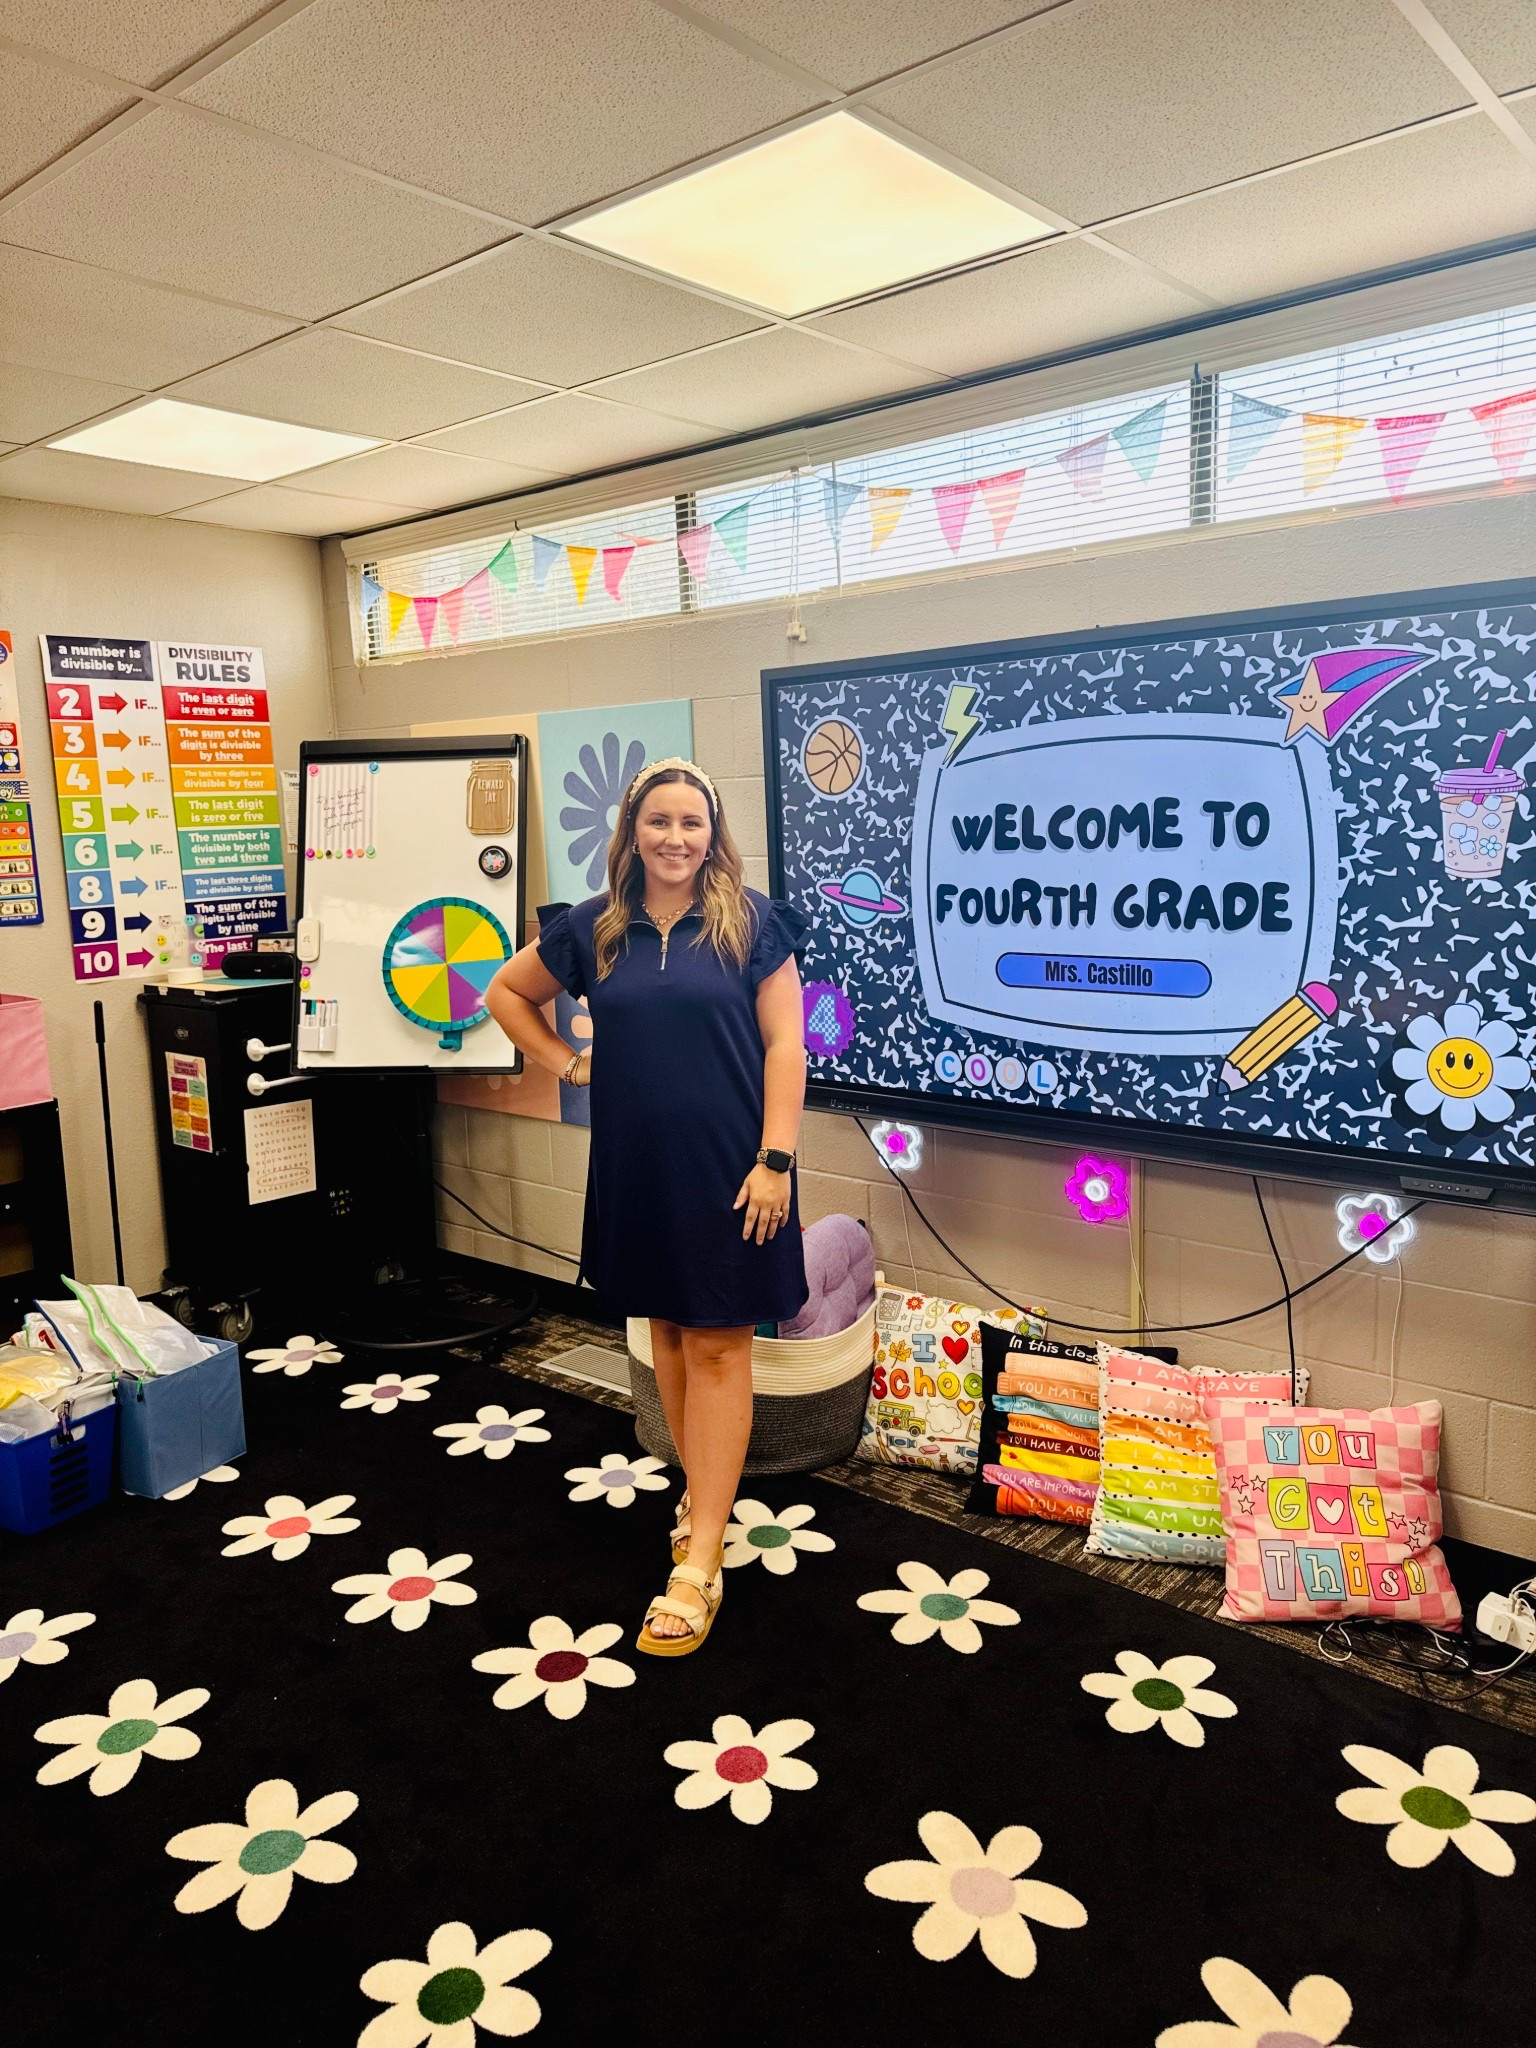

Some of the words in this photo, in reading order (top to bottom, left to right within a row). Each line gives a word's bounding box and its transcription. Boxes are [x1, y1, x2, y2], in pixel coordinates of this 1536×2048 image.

[58, 645, 68, 655] a
[71, 645, 126, 658] number
[129, 647, 142, 659] is
[168, 647, 253, 662] DIVISIBILITY
[60, 658, 114, 671] divisible
[176, 662, 251, 683] RULES
[57, 687, 82, 717] 2
[178, 692, 200, 703] The
[202, 693, 224, 704] last
[226, 694, 254, 706] digit
[181, 705, 190, 714] is
[192, 707, 216, 717] even
[218, 707, 230, 715] or
[231, 708, 254, 717] zero
[62, 725, 86, 754] 3
[178, 728, 198, 738] The
[201, 730, 225, 739] sum
[227, 729, 240, 738] of
[242, 729, 261, 739] the
[180, 740, 208, 750] digits
[210, 740, 218, 749] is
[220, 741, 261, 750] divisible
[199, 751, 212, 762] by
[215, 752, 244, 762] three
[65, 763, 91, 791] 4
[228, 770, 249, 778] digits
[184, 780, 226, 788] divisible
[228, 780, 241, 789] by
[244, 780, 264, 788] four
[478, 778, 504, 791] REWARD
[188, 800, 209, 810] The
[212, 800, 234, 810] last
[236, 798, 264, 810] digit
[485, 791, 497, 805] JAR
[72, 801, 94, 829] 5
[191, 813, 200, 822] is
[203, 814, 226, 823] zero
[229, 813, 241, 821] or
[244, 812, 264, 822] five
[952, 797, 1184, 852] WELCOME
[1202, 800, 1270, 848] TO
[188, 832, 210, 842] The
[212, 831, 258, 842] number
[260, 830, 270, 840] is
[74, 838, 98, 866] 6
[191, 844, 232, 853] divisible
[234, 842, 246, 852] by
[248, 842, 270, 852] both
[194, 856, 216, 866] two
[218, 854, 238, 864] and
[240, 852, 269, 862] three
[195, 878, 209, 886] The
[211, 876, 226, 885] last
[226, 876, 248, 884] three
[250, 874, 272, 884] digits
[79, 876, 103, 904] 8
[196, 887, 208, 895] are
[209, 885, 242, 894] divisible
[242, 885, 252, 893] by
[254, 884, 274, 892] eight
[194, 904, 216, 914] The
[218, 902, 242, 913] sum
[244, 900, 257, 910] of
[259, 898, 278, 908] the
[936, 878, 1097, 928] FOURTH
[1113, 878, 1293, 932] GRADE
[226, 913, 235, 921] is
[237, 910, 276, 920] divisible
[82, 910, 106, 939] 9
[218, 924, 232, 936] by
[234, 922, 259, 933] nine
[204, 944, 224, 954] The
[227, 942, 248, 953] last
[80, 950, 114, 974] 10
[1044, 960, 1083, 984] Mrs.
[1087, 961, 1154, 987] Castillo
[808, 994, 842, 1046] 4
[940, 1055, 1051, 1089] COOL
[912, 1334, 937, 1363] I
[1008, 1335, 1022, 1348] In
[1028, 1339, 1060, 1354] this
[1137, 1366, 1142, 1376] I
[1155, 1368, 1189, 1384] AM
[1198, 1380, 1261, 1393] BRAVE
[1017, 1381, 1044, 1394] YOU
[1048, 1384, 1099, 1404] MATTE
[1016, 1401, 1036, 1410] YOU
[1041, 1406, 1060, 1416] ARE
[1063, 1411, 1099, 1425] VALUE
[1146, 1396, 1150, 1406] I
[1164, 1400, 1196, 1414] AM
[1012, 1420, 1032, 1429] YOU
[1038, 1422, 1060, 1434] ARE
[1136, 1422, 1140, 1432] I
[1153, 1426, 1182, 1442] AM
[1008, 1435, 1027, 1446] YOU
[1030, 1438, 1062, 1452] HAVE
[1066, 1446, 1075, 1455] A
[1268, 1430, 1373, 1462] You
[1134, 1450, 1138, 1459] I
[1152, 1451, 1184, 1468] AM
[996, 1472, 1016, 1483] YOU
[1019, 1476, 1041, 1488] ARE
[1044, 1481, 1097, 1499] IMPORTAN
[1125, 1478, 1130, 1488] I
[1144, 1478, 1178, 1492] AM
[1028, 1496, 1057, 1512] YOU
[1063, 1504, 1094, 1520] ARE
[1126, 1507, 1131, 1517] I
[1144, 1509, 1178, 1524] AM
[1028, 1510, 1090, 1527] RESPECTE
[1135, 1536, 1168, 1550] AM
[1265, 1550, 1423, 1596] This!
